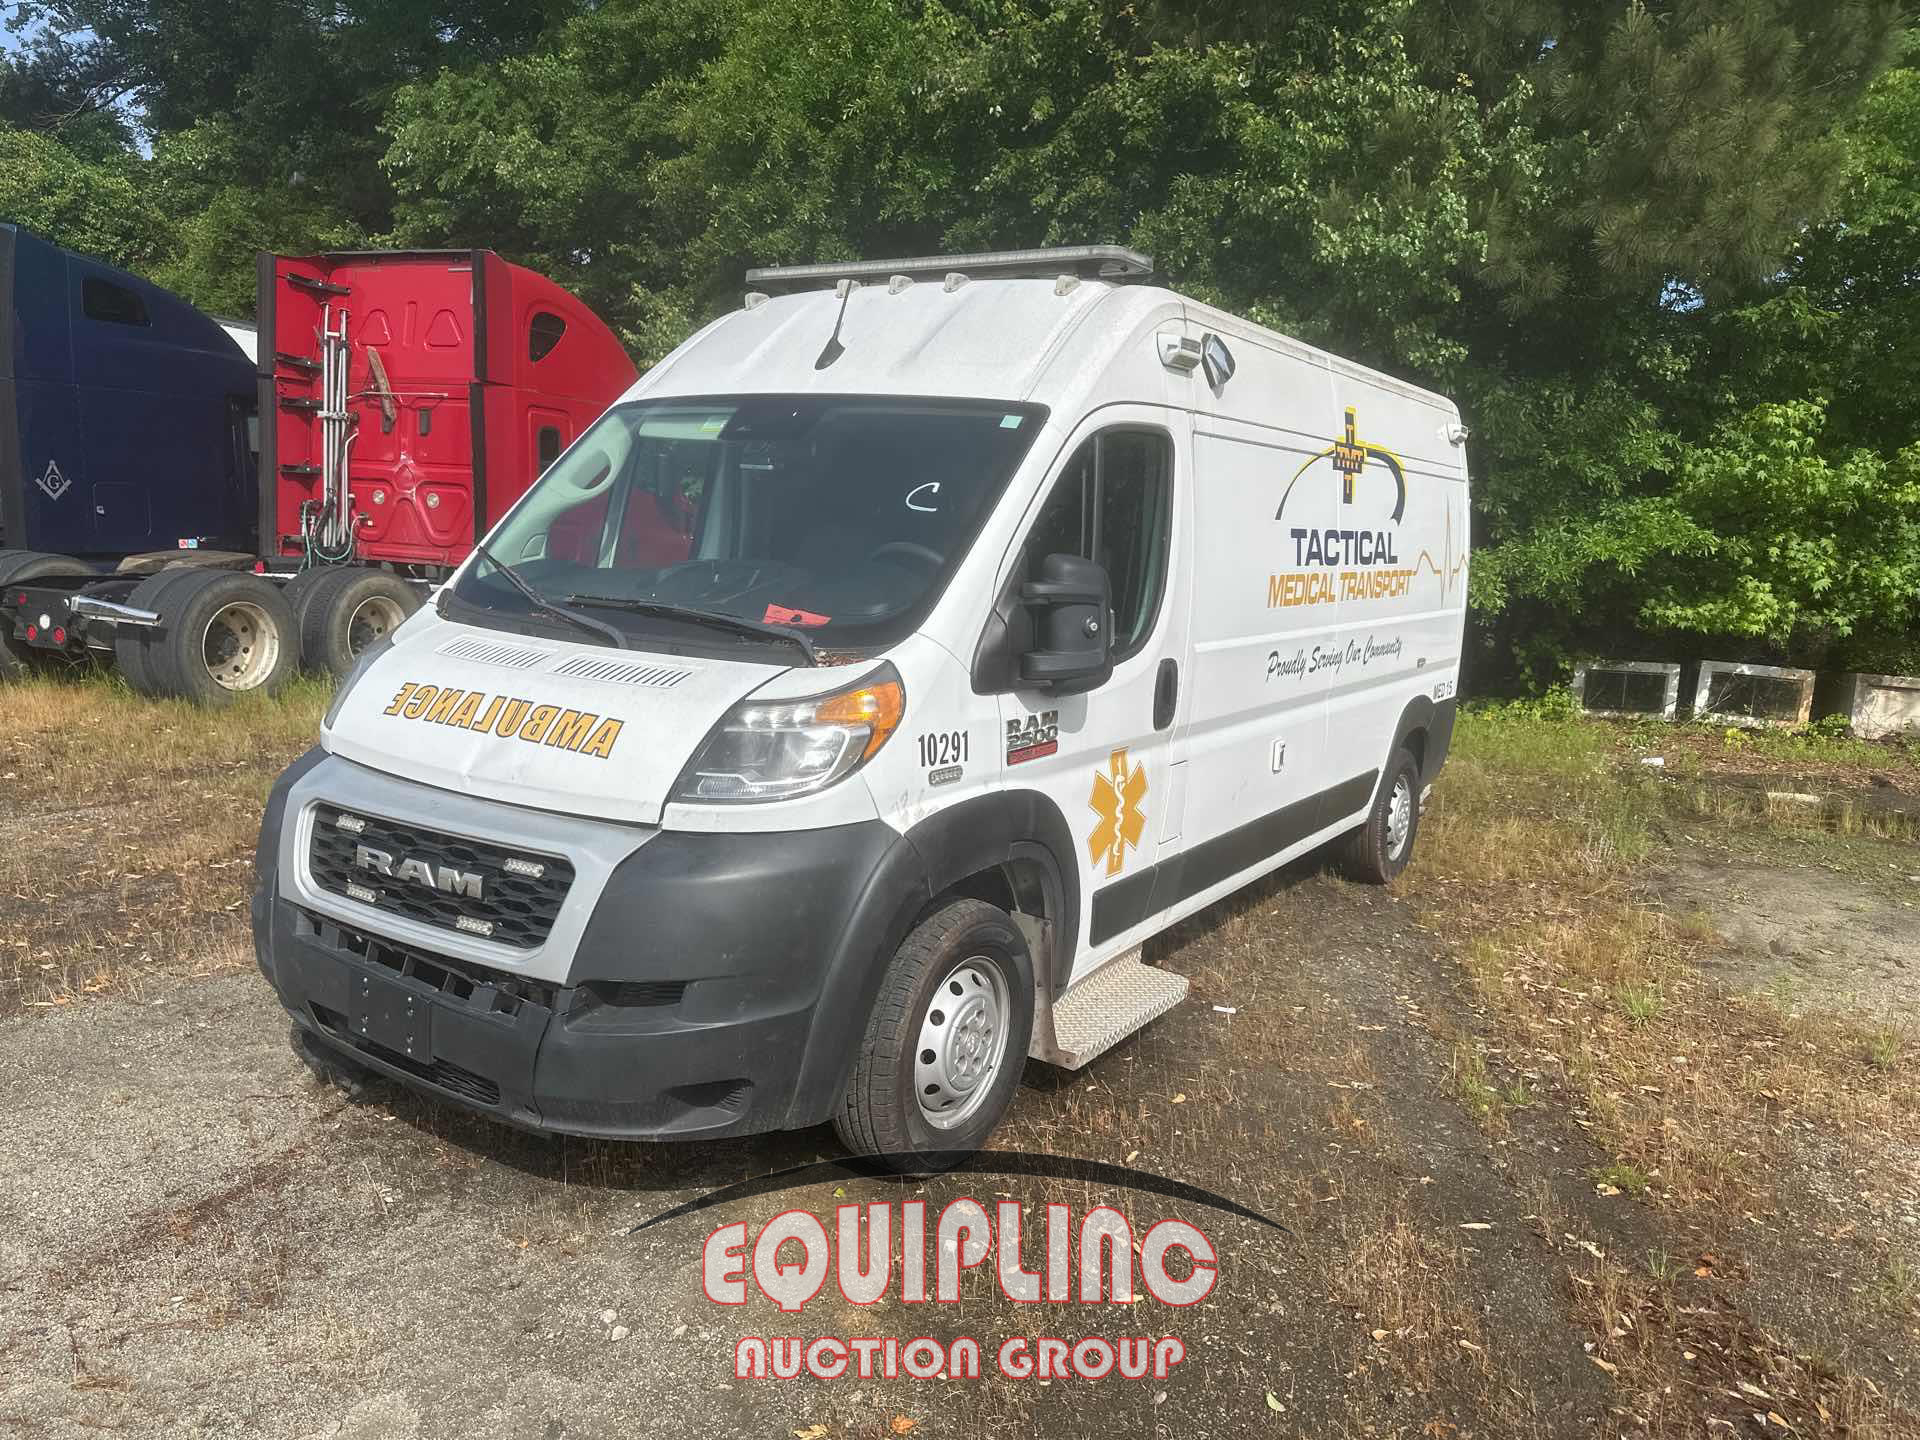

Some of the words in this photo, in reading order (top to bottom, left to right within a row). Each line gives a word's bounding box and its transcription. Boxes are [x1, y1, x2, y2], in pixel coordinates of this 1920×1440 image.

[47, 474, 60, 490] G
[905, 481, 940, 512] C
[1290, 528, 1398, 567] TACTICAL
[1266, 572, 1336, 608] MEDICAL
[1340, 570, 1412, 601] TRANSPORT
[1265, 648, 1306, 683] Proudly
[1308, 645, 1343, 675] Serving
[1345, 638, 1362, 665] Our
[1363, 634, 1402, 661] Community
[1006, 710, 1059, 735] RAM
[1006, 726, 1058, 748] 2500
[918, 730, 969, 767] 10291
[356, 844, 484, 900] RAM
